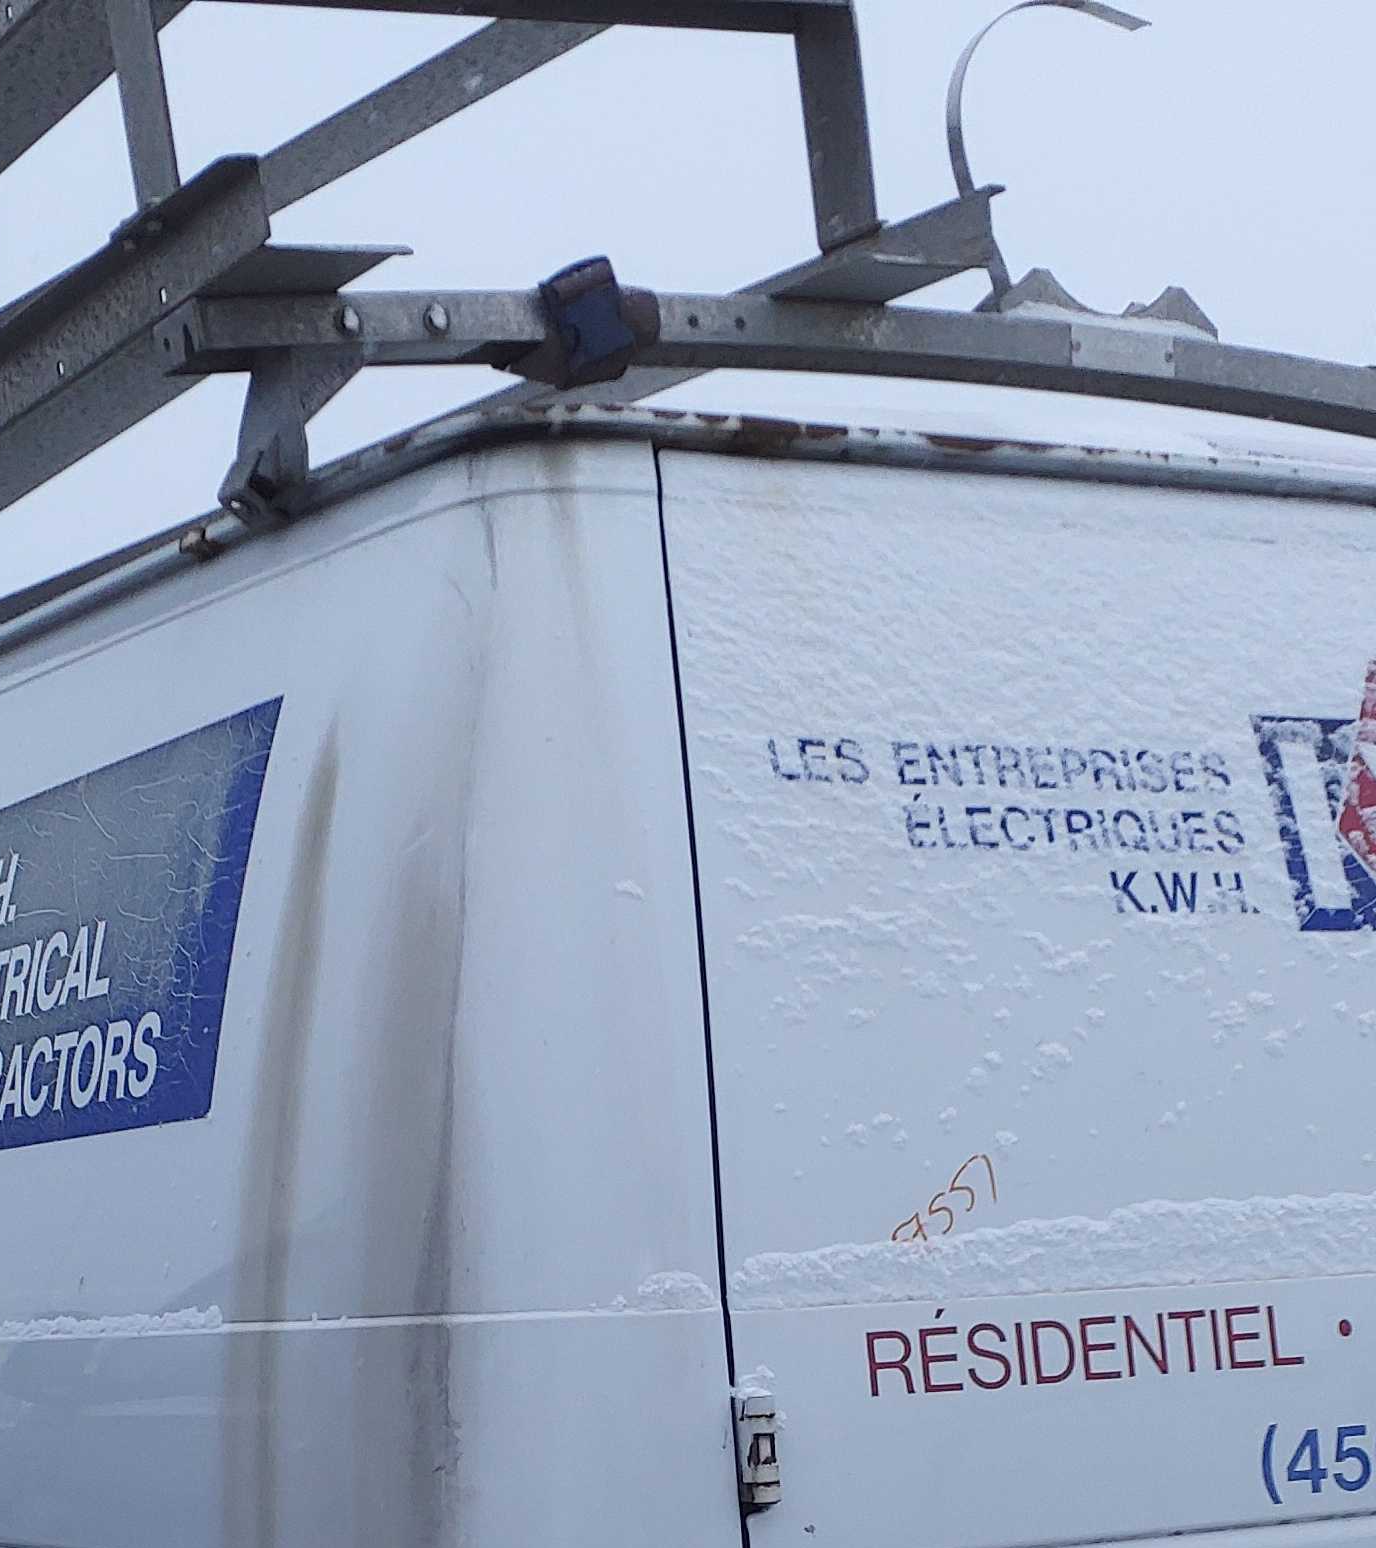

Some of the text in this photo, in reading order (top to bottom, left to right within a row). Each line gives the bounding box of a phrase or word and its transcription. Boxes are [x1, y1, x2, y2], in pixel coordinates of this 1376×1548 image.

[766, 738, 1232, 793] LES ENTREPRISES
[903, 792, 1246, 854] ÉLECTRIQUES
[864, 1308, 1305, 1397] RÉSIDENTIEL
